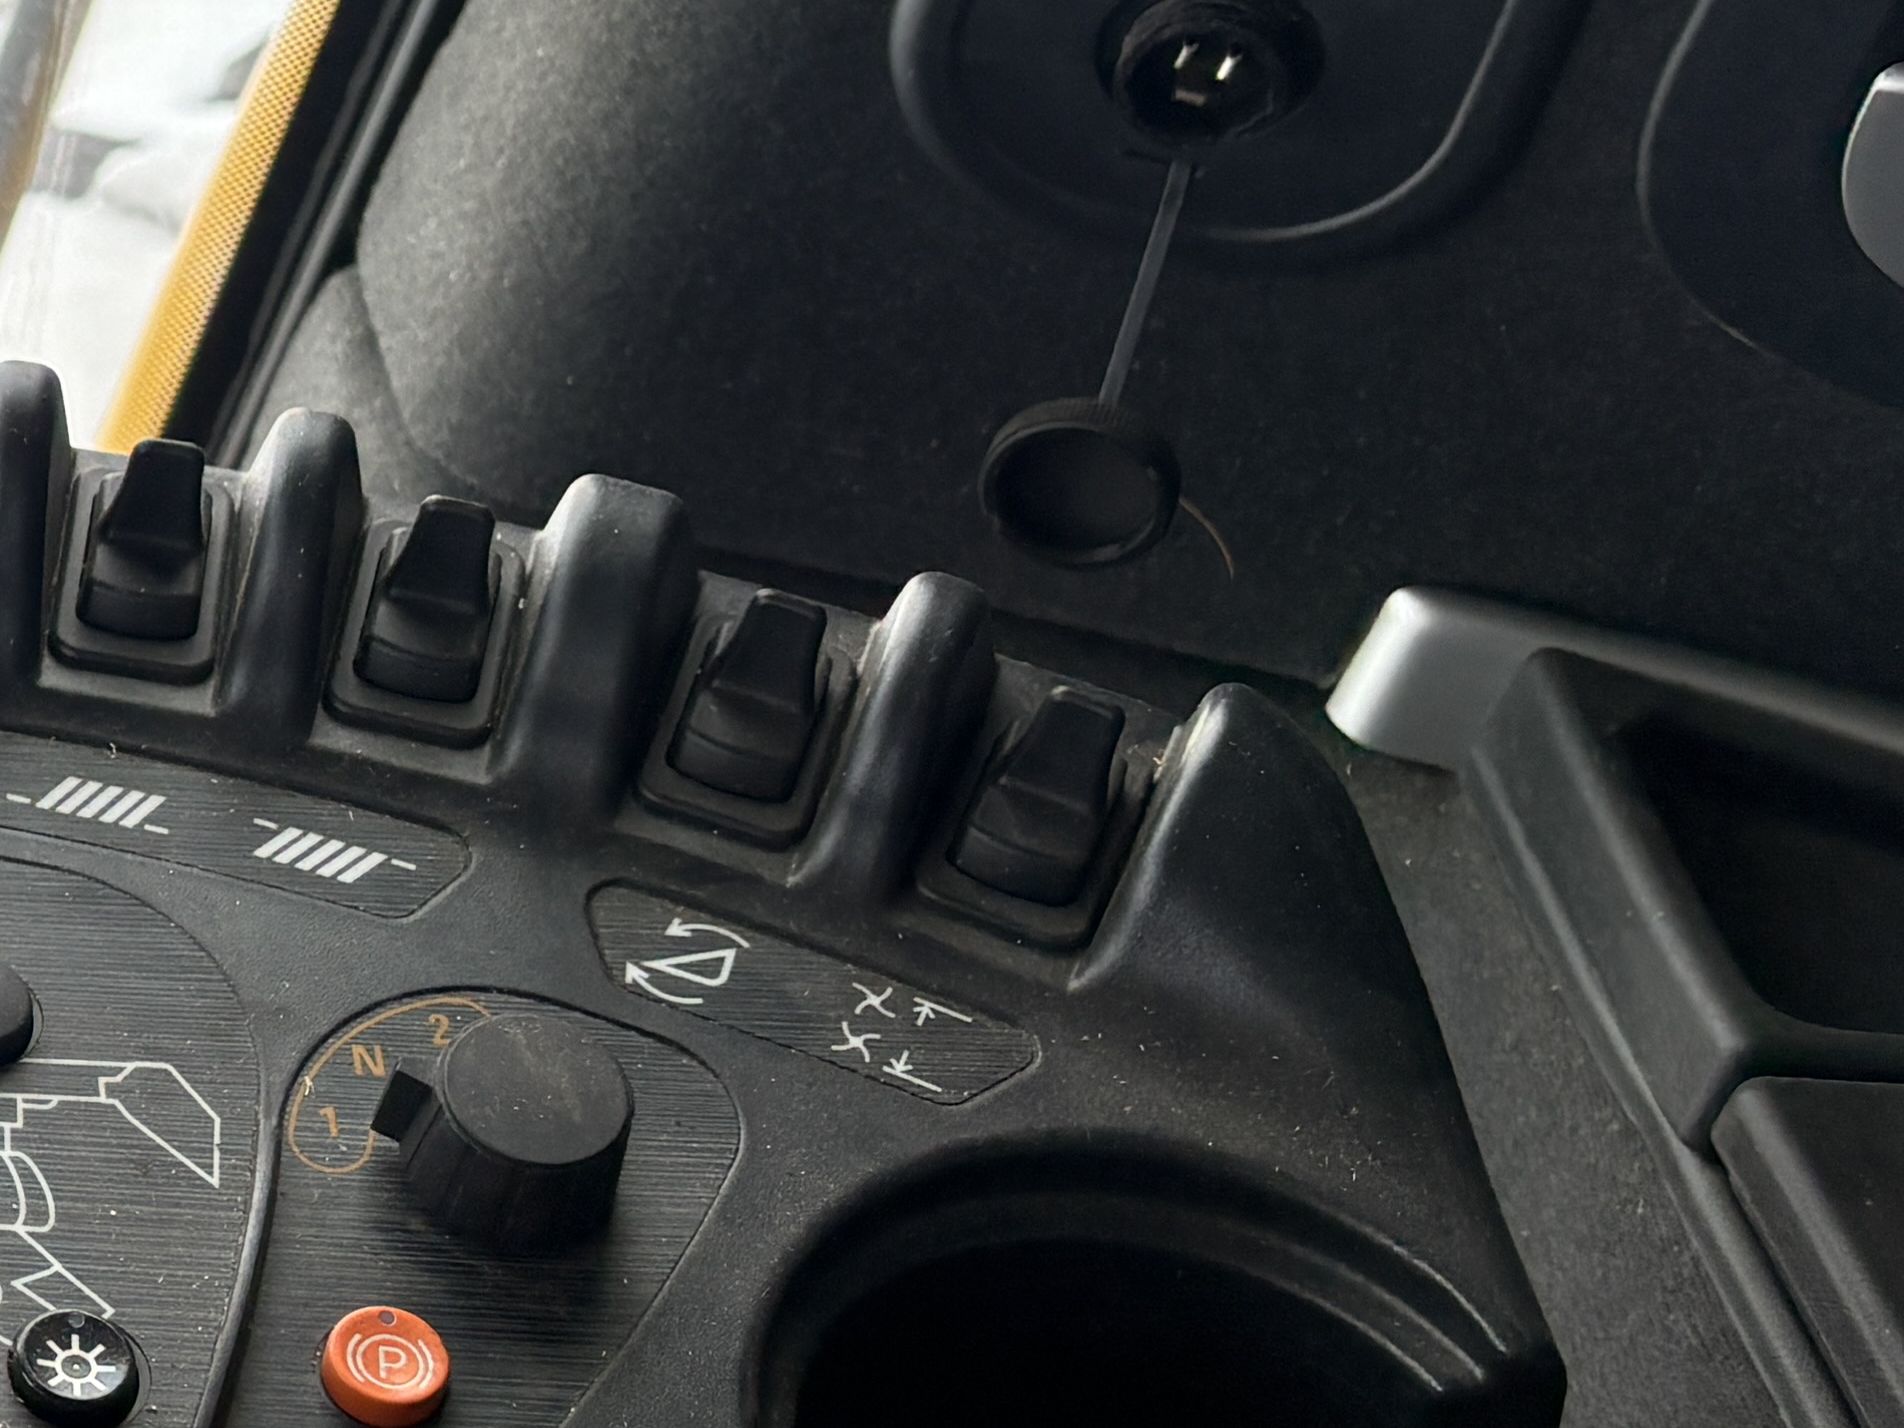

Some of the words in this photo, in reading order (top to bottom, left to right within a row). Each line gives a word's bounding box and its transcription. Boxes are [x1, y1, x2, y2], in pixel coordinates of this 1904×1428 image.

[429, 1014, 451, 1046] 2
[351, 1044, 387, 1078] N
[319, 1106, 341, 1138] 1
[377, 1345, 407, 1379] P
